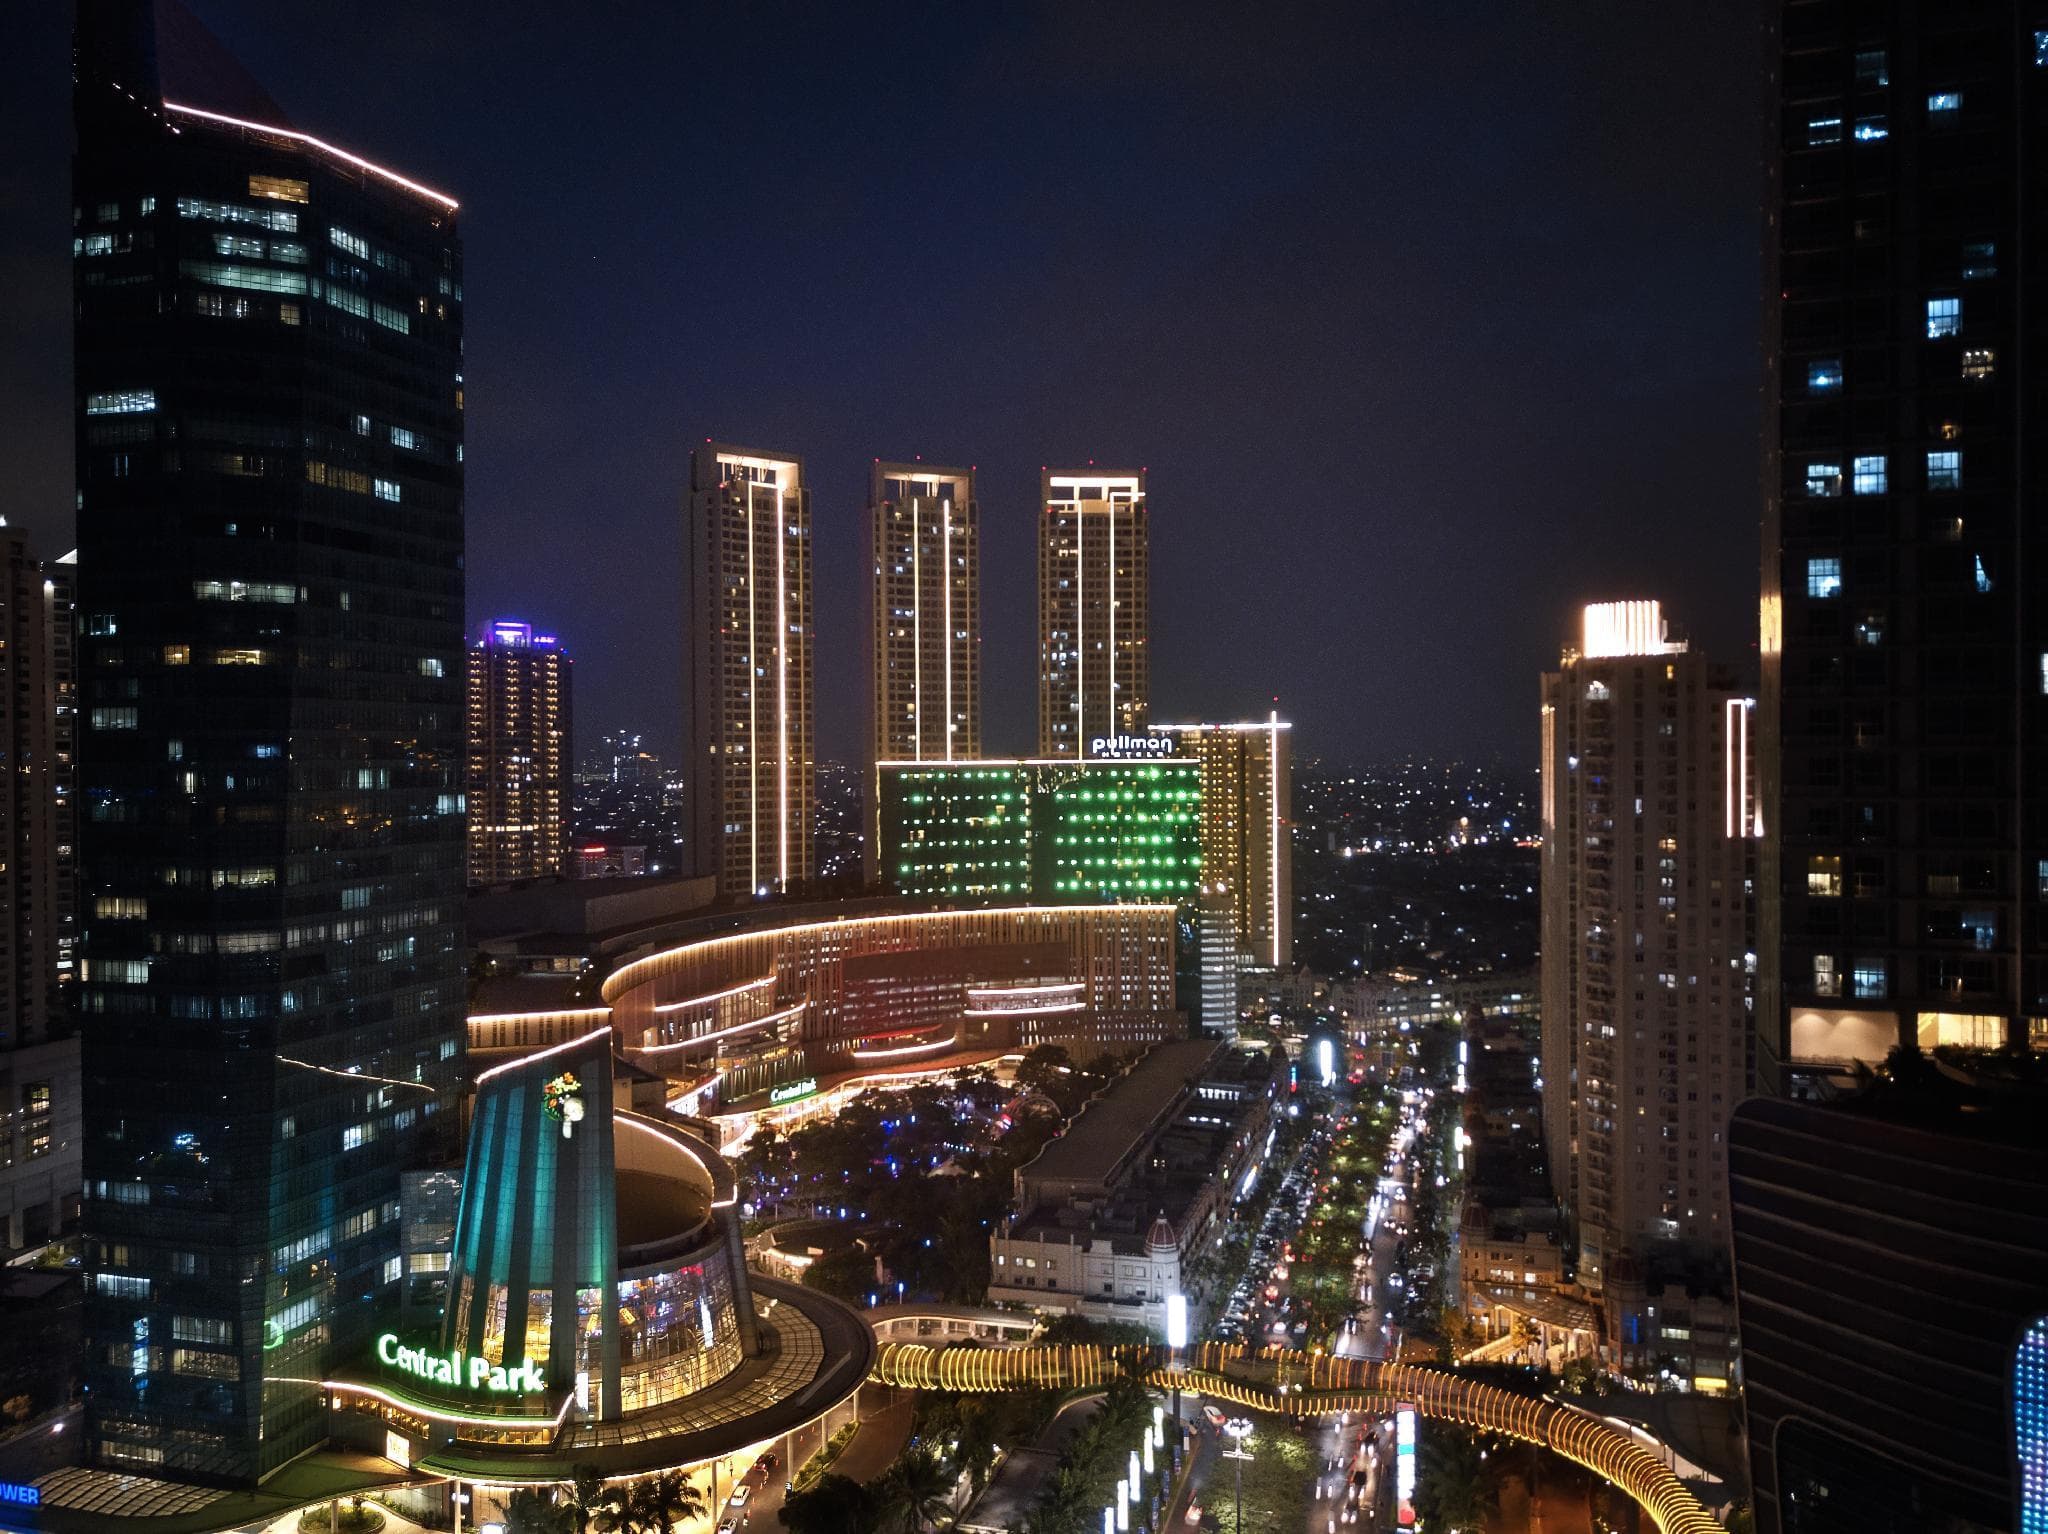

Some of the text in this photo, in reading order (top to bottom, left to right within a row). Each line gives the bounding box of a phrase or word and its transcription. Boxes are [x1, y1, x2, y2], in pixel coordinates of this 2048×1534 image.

[1092, 735, 1172, 753] pullman
[377, 1333, 545, 1392] Central Park
